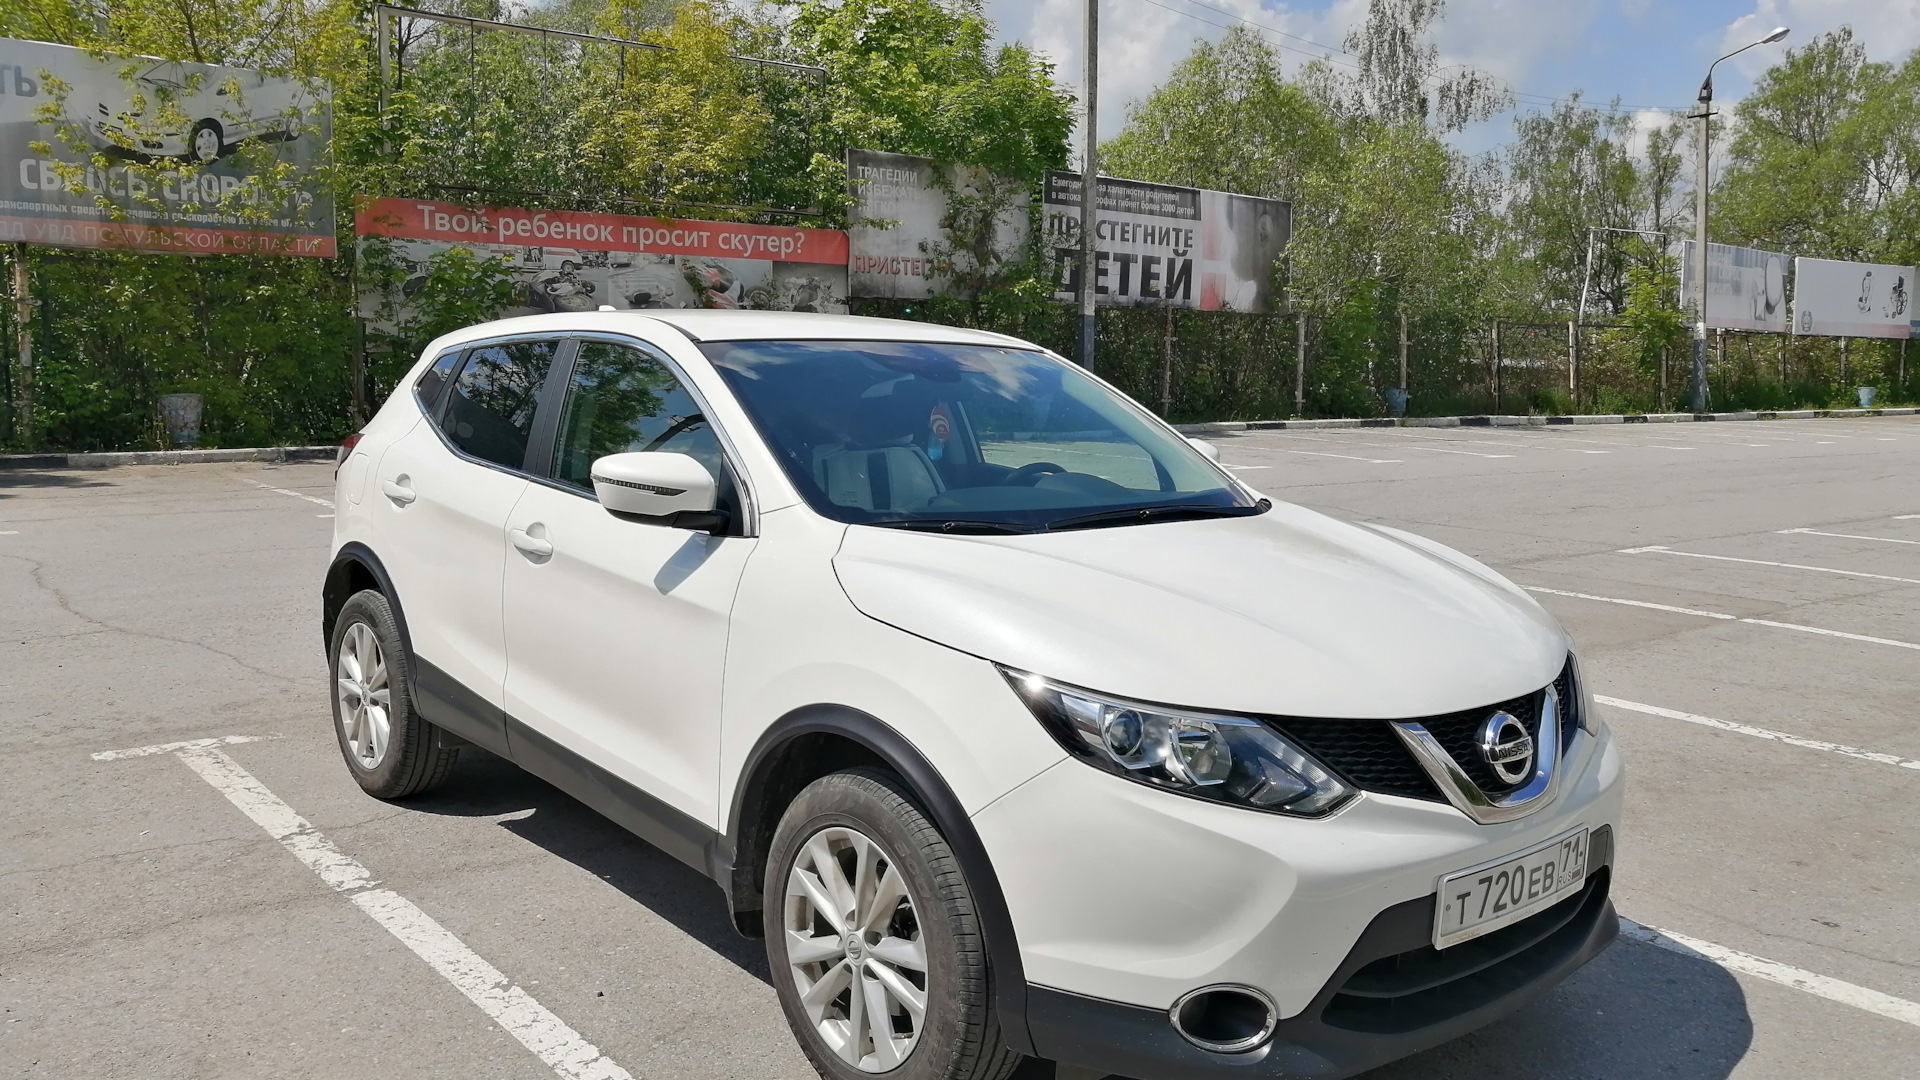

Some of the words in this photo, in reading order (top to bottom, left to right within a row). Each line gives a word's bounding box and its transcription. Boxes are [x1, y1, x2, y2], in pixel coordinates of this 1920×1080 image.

[857, 166, 917, 184] ТРАГЕДИИ
[857, 183, 922, 200] ИЗБЕЖАТЬ
[1052, 176, 1083, 190] Ежегодн
[1107, 185, 1144, 197] халатности
[1145, 190, 1179, 201] родителей
[1140, 200, 1160, 211] более
[1161, 203, 1176, 213] 3000
[1176, 206, 1195, 215] детей
[34, 223, 76, 243] УВД
[123, 228, 224, 249] ТУЛЬСКОЙ
[417, 204, 488, 234] Твой
[499, 213, 614, 243] ребенок
[622, 225, 711, 251] просит
[718, 232, 805, 259] скутер?
[1050, 216, 1193, 248] ПРСТЕГНИТЕ
[1054, 247, 1193, 302] ДЕТЕЙ
[1563, 836, 1580, 873] 71
[1558, 870, 1571, 886] RUS
